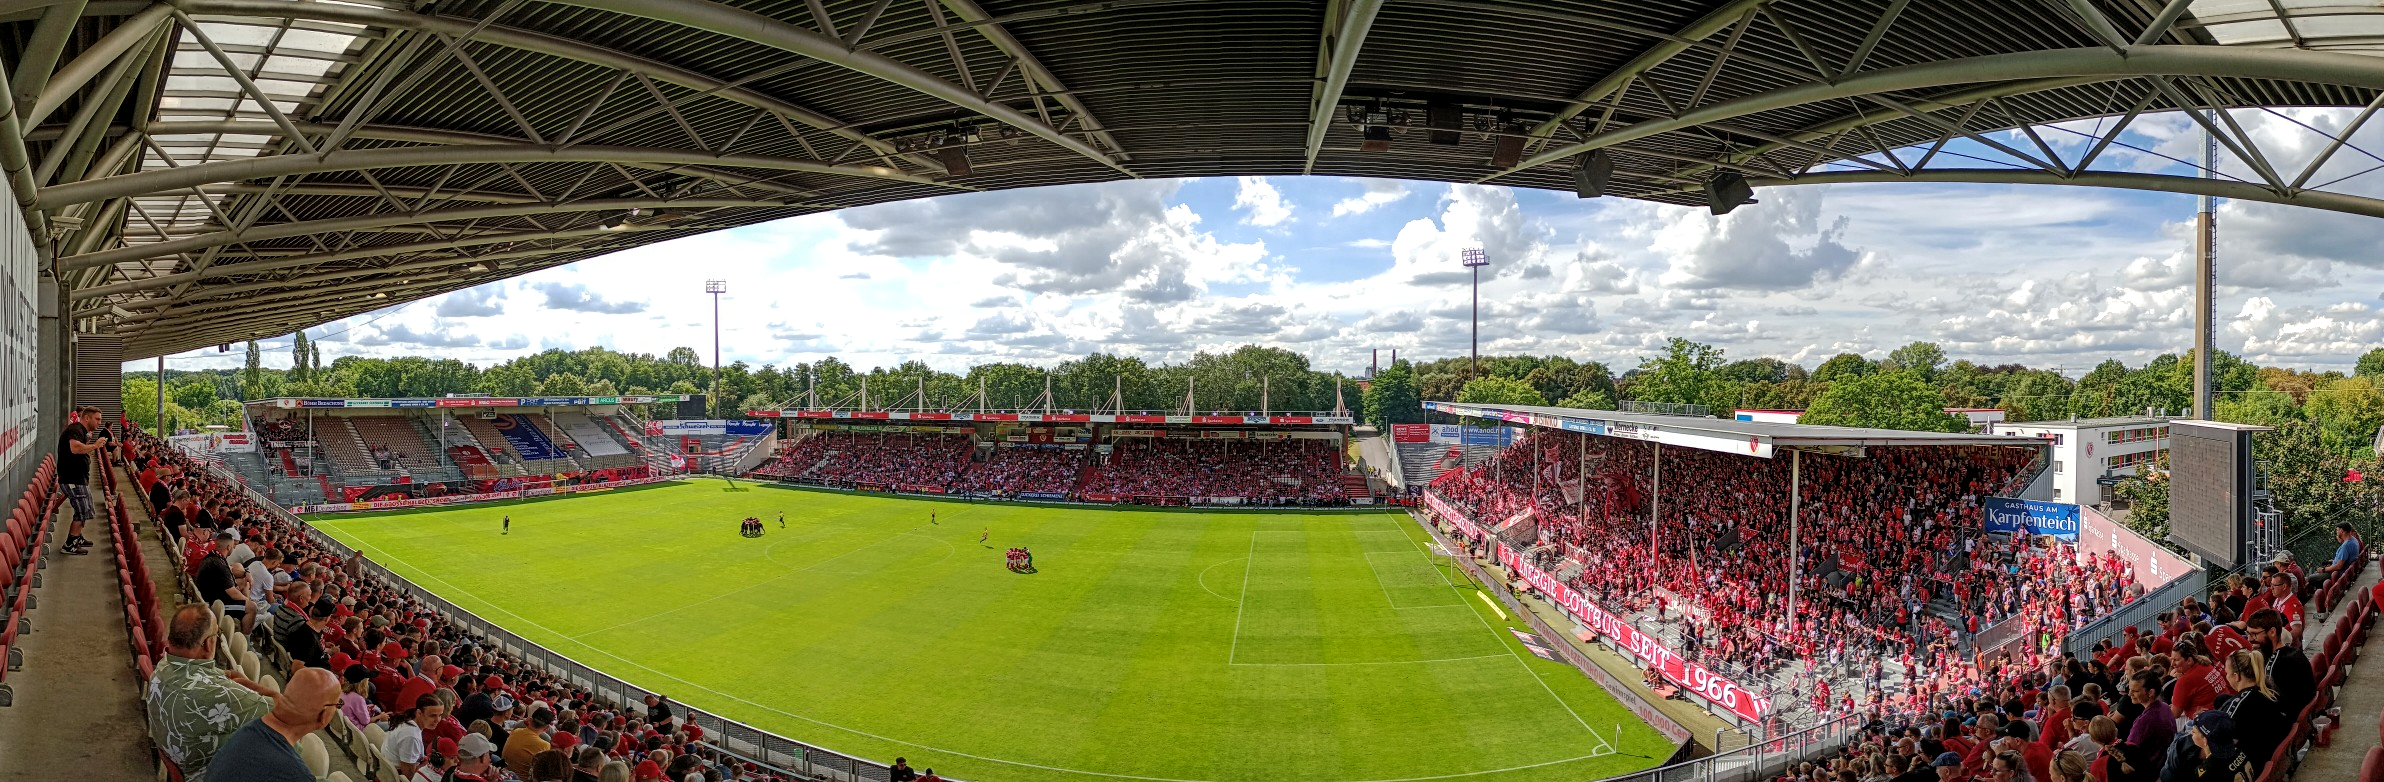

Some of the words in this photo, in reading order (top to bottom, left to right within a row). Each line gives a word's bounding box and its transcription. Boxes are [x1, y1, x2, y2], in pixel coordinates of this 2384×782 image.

[1613, 420, 1638, 432] Wernecke
[617, 467, 647, 477] BAUTEC
[2004, 502, 2044, 512] GASTHAUS
[2045, 505, 2058, 513] AM
[1988, 508, 2076, 532] Karpfenteich
[2117, 541, 2140, 563] Sparkasse
[1519, 556, 1557, 598] ENERGIE
[1564, 588, 1621, 641] COTTBUS
[1630, 630, 1671, 671] SEIT
[1681, 663, 1737, 710] 1966
[1559, 639, 1605, 684] HALBZEITSHOW
[1605, 679, 1637, 706] Gewinnspiel
[1639, 705, 1671, 732] 100.000
